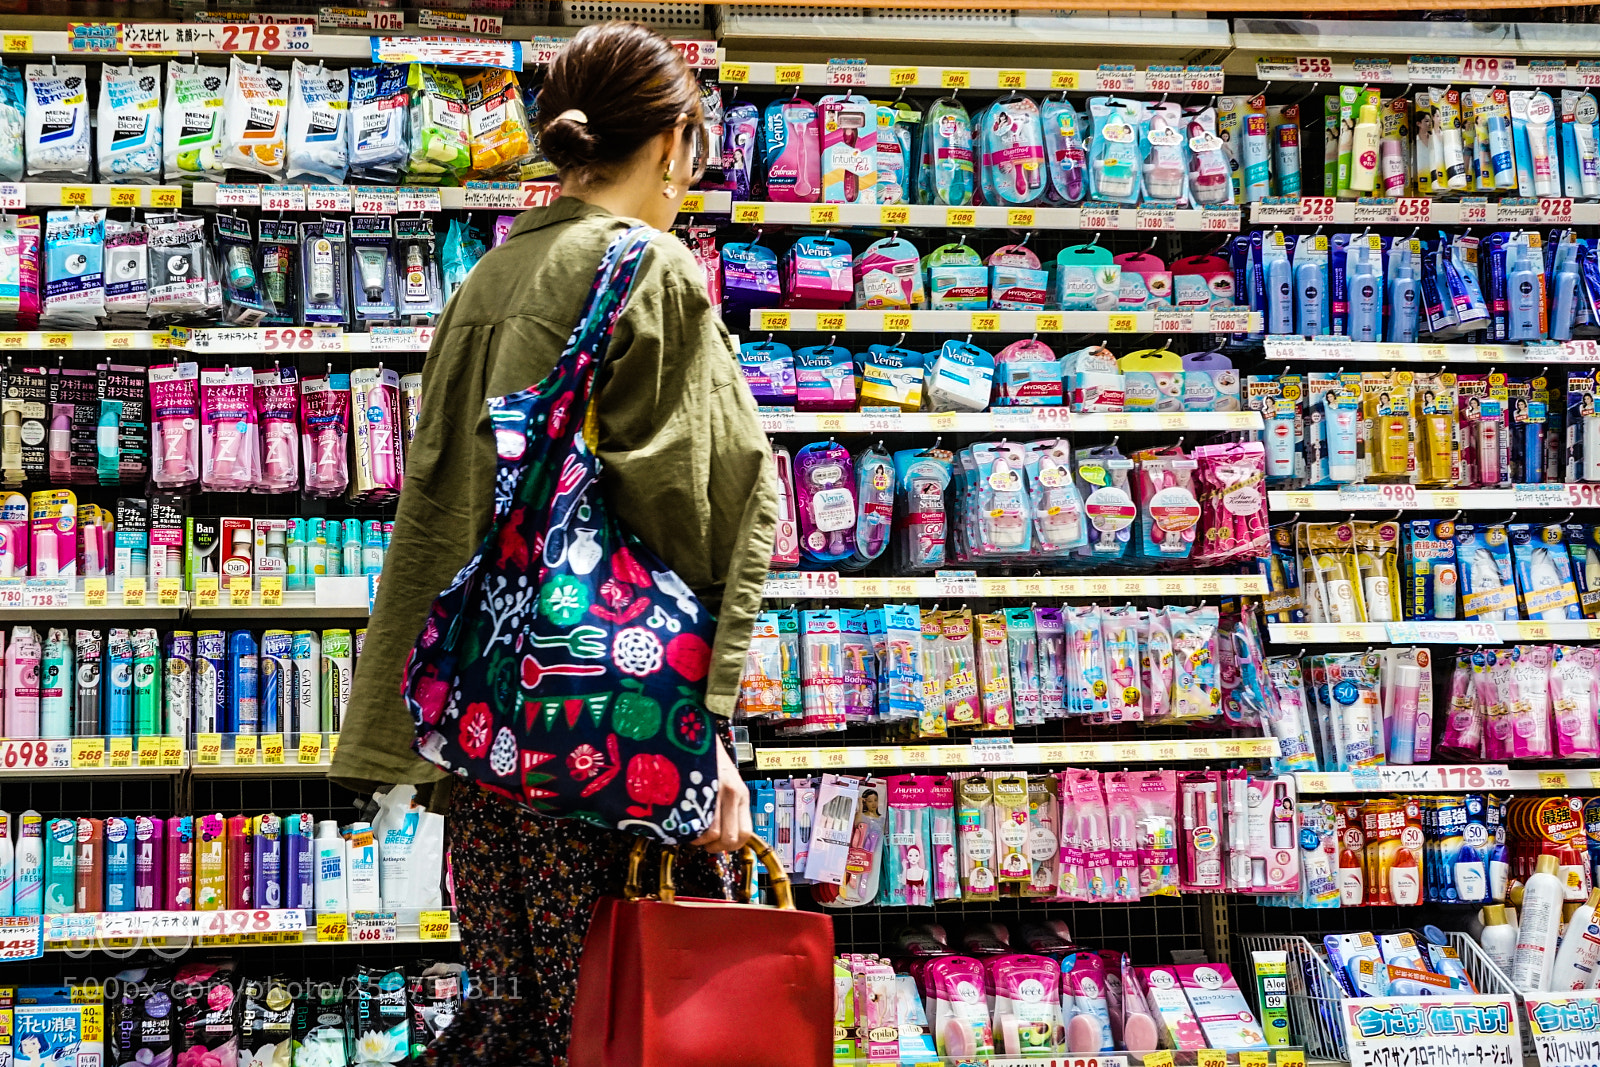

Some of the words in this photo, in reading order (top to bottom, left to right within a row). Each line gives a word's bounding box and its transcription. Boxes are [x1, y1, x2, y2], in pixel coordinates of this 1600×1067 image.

[222, 25, 280, 51] 278
[1300, 58, 1331, 73] 558
[1462, 58, 1499, 80] 498
[833, 73, 852, 84] 598
[1103, 80, 1122, 90] 980
[1152, 81, 1170, 90] 980
[1191, 81, 1210, 90] 980
[768, 112, 784, 153] Venus
[269, 199, 290, 208] 848
[316, 200, 336, 208] 598
[362, 202, 382, 212] 928
[405, 200, 426, 210] 738
[1302, 198, 1334, 214] 528
[1399, 200, 1430, 216] 658
[1541, 200, 1572, 215] 928
[1468, 208, 1486, 218] 598
[1086, 217, 1106, 227] 1080
[1143, 218, 1162, 228] 1080
[1208, 219, 1227, 229] 1080
[724, 248, 756, 262] Venus
[798, 244, 832, 257] Venus
[1161, 321, 1180, 330] 1080
[1216, 321, 1235, 330] 1080
[264, 328, 314, 350] 598
[740, 350, 772, 362] Venus
[870, 352, 904, 368] Venus
[946, 343, 974, 366] Venus
[800, 354, 832, 367] Venus
[154, 373, 174, 382] Bioré
[206, 376, 226, 385] Bioré
[355, 376, 375, 384] Bioré
[98, 380, 107, 400] Ban
[206, 386, 248, 398] たくさん汗
[304, 384, 324, 393] Bioré
[1038, 406, 1070, 422] 498
[1384, 486, 1415, 501] 980
[1569, 486, 1600, 506] 598
[196, 524, 214, 534] Ban
[1546, 530, 1558, 540] 35
[227, 562, 245, 572] ban
[260, 556, 281, 567] Ban
[806, 573, 838, 590] 148
[945, 585, 964, 594] 208
[31, 595, 53, 606] 738
[1464, 623, 1494, 637] 728
[812, 677, 830, 685] Face
[844, 676, 860, 685] Body
[302, 669, 312, 708] GATSBY
[4, 741, 48, 768] 698
[78, 750, 102, 760] 568
[113, 750, 130, 758] 568
[265, 746, 282, 754] 528
[982, 752, 1001, 762] 208
[1437, 767, 1484, 787] 178
[964, 784, 990, 794] Schick
[1377, 812, 1405, 828] 最強
[1438, 808, 1468, 826] 最強
[1542, 808, 1572, 824] 最強
[388, 829, 401, 837] SEA
[385, 835, 414, 845] BREEZE
[321, 864, 341, 874] COOL
[208, 910, 271, 934] 498
[322, 925, 346, 934] 462
[425, 924, 448, 932] 1280
[359, 928, 381, 940] 668
[1152, 974, 1173, 984] Veet
[1196, 972, 1222, 983] Veet
[1266, 978, 1286, 989] Aloe
[360, 992, 371, 1019] Ban
[1268, 996, 1282, 1006] 99
[18, 1015, 78, 1034] 汗とり消臭
[243, 1010, 254, 1036] Ban
[1357, 1007, 1424, 1036] 今だけ!
[1430, 1006, 1508, 1033] 値下げ!
[122, 1020, 133, 1049] Ban
[871, 1029, 896, 1042] epilat
